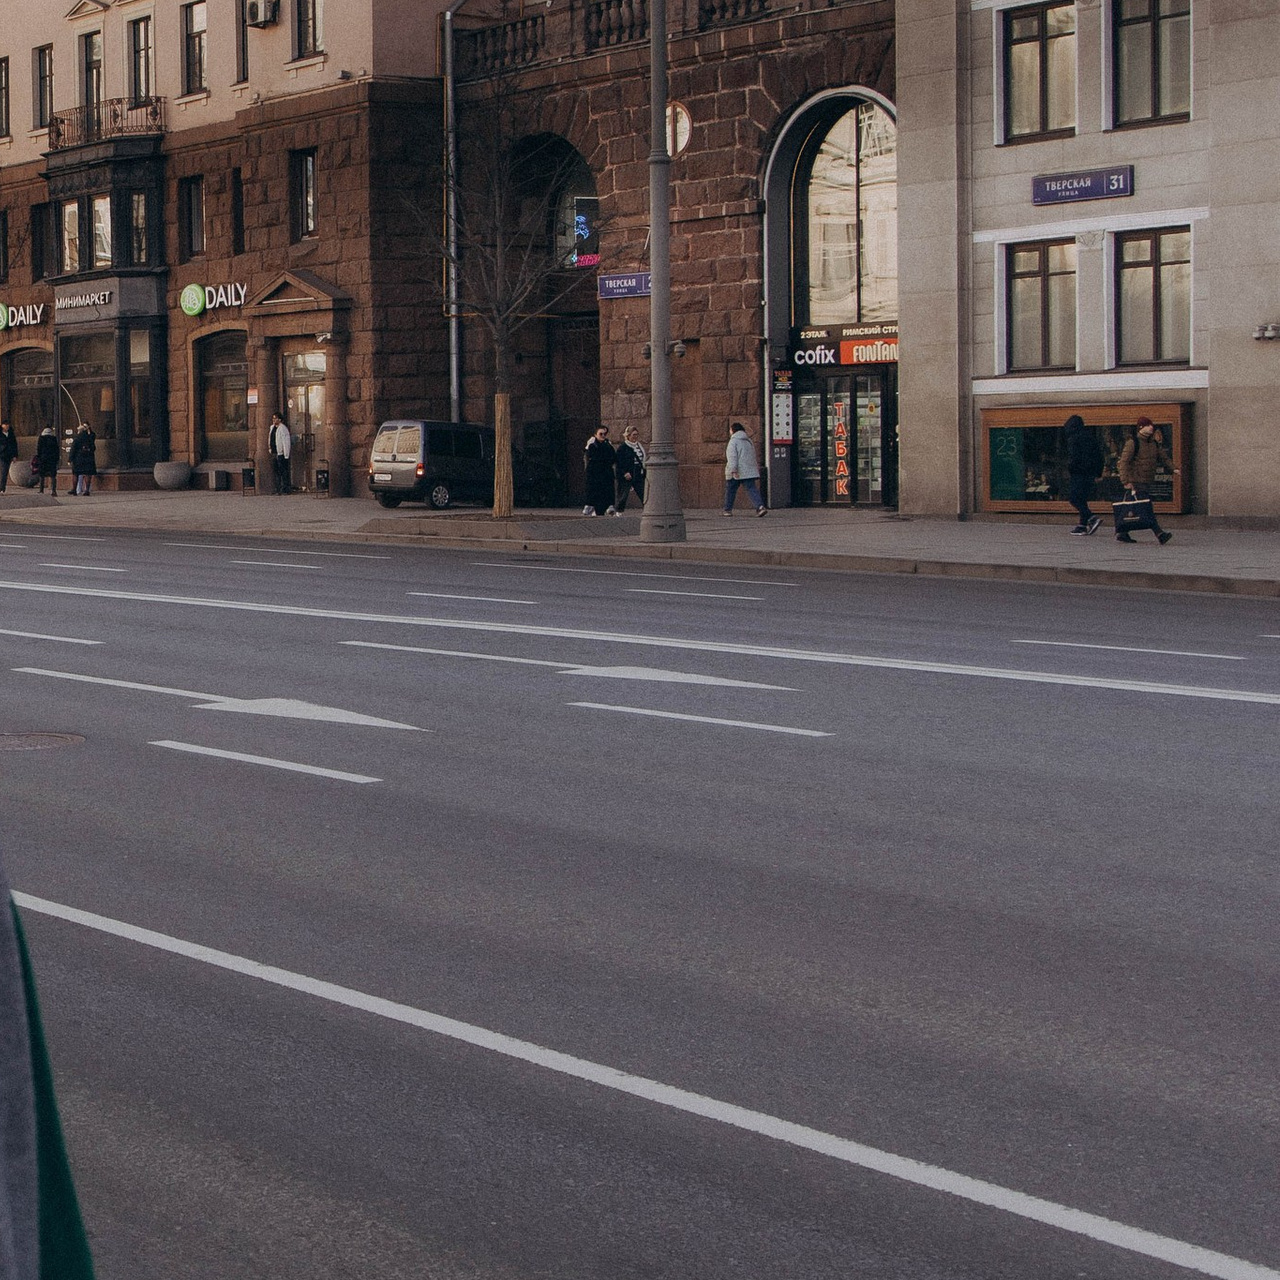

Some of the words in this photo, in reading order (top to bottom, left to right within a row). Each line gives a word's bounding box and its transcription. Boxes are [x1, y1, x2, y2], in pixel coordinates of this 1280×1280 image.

[1045, 177, 1091, 191] ТВЕРСКАЯ
[1109, 175, 1124, 190] 31
[605, 278, 636, 288] ТВЕРСКАЯ
[55, 291, 110, 310] МИНИМАРКЕТ
[205, 283, 247, 309] DAILY
[8, 303, 44, 327] DAILY
[843, 325, 881, 336] РИМСКИЙ
[794, 345, 836, 365] cofix
[834, 402, 848, 495] ТАБАК
[997, 436, 1018, 456] 23
